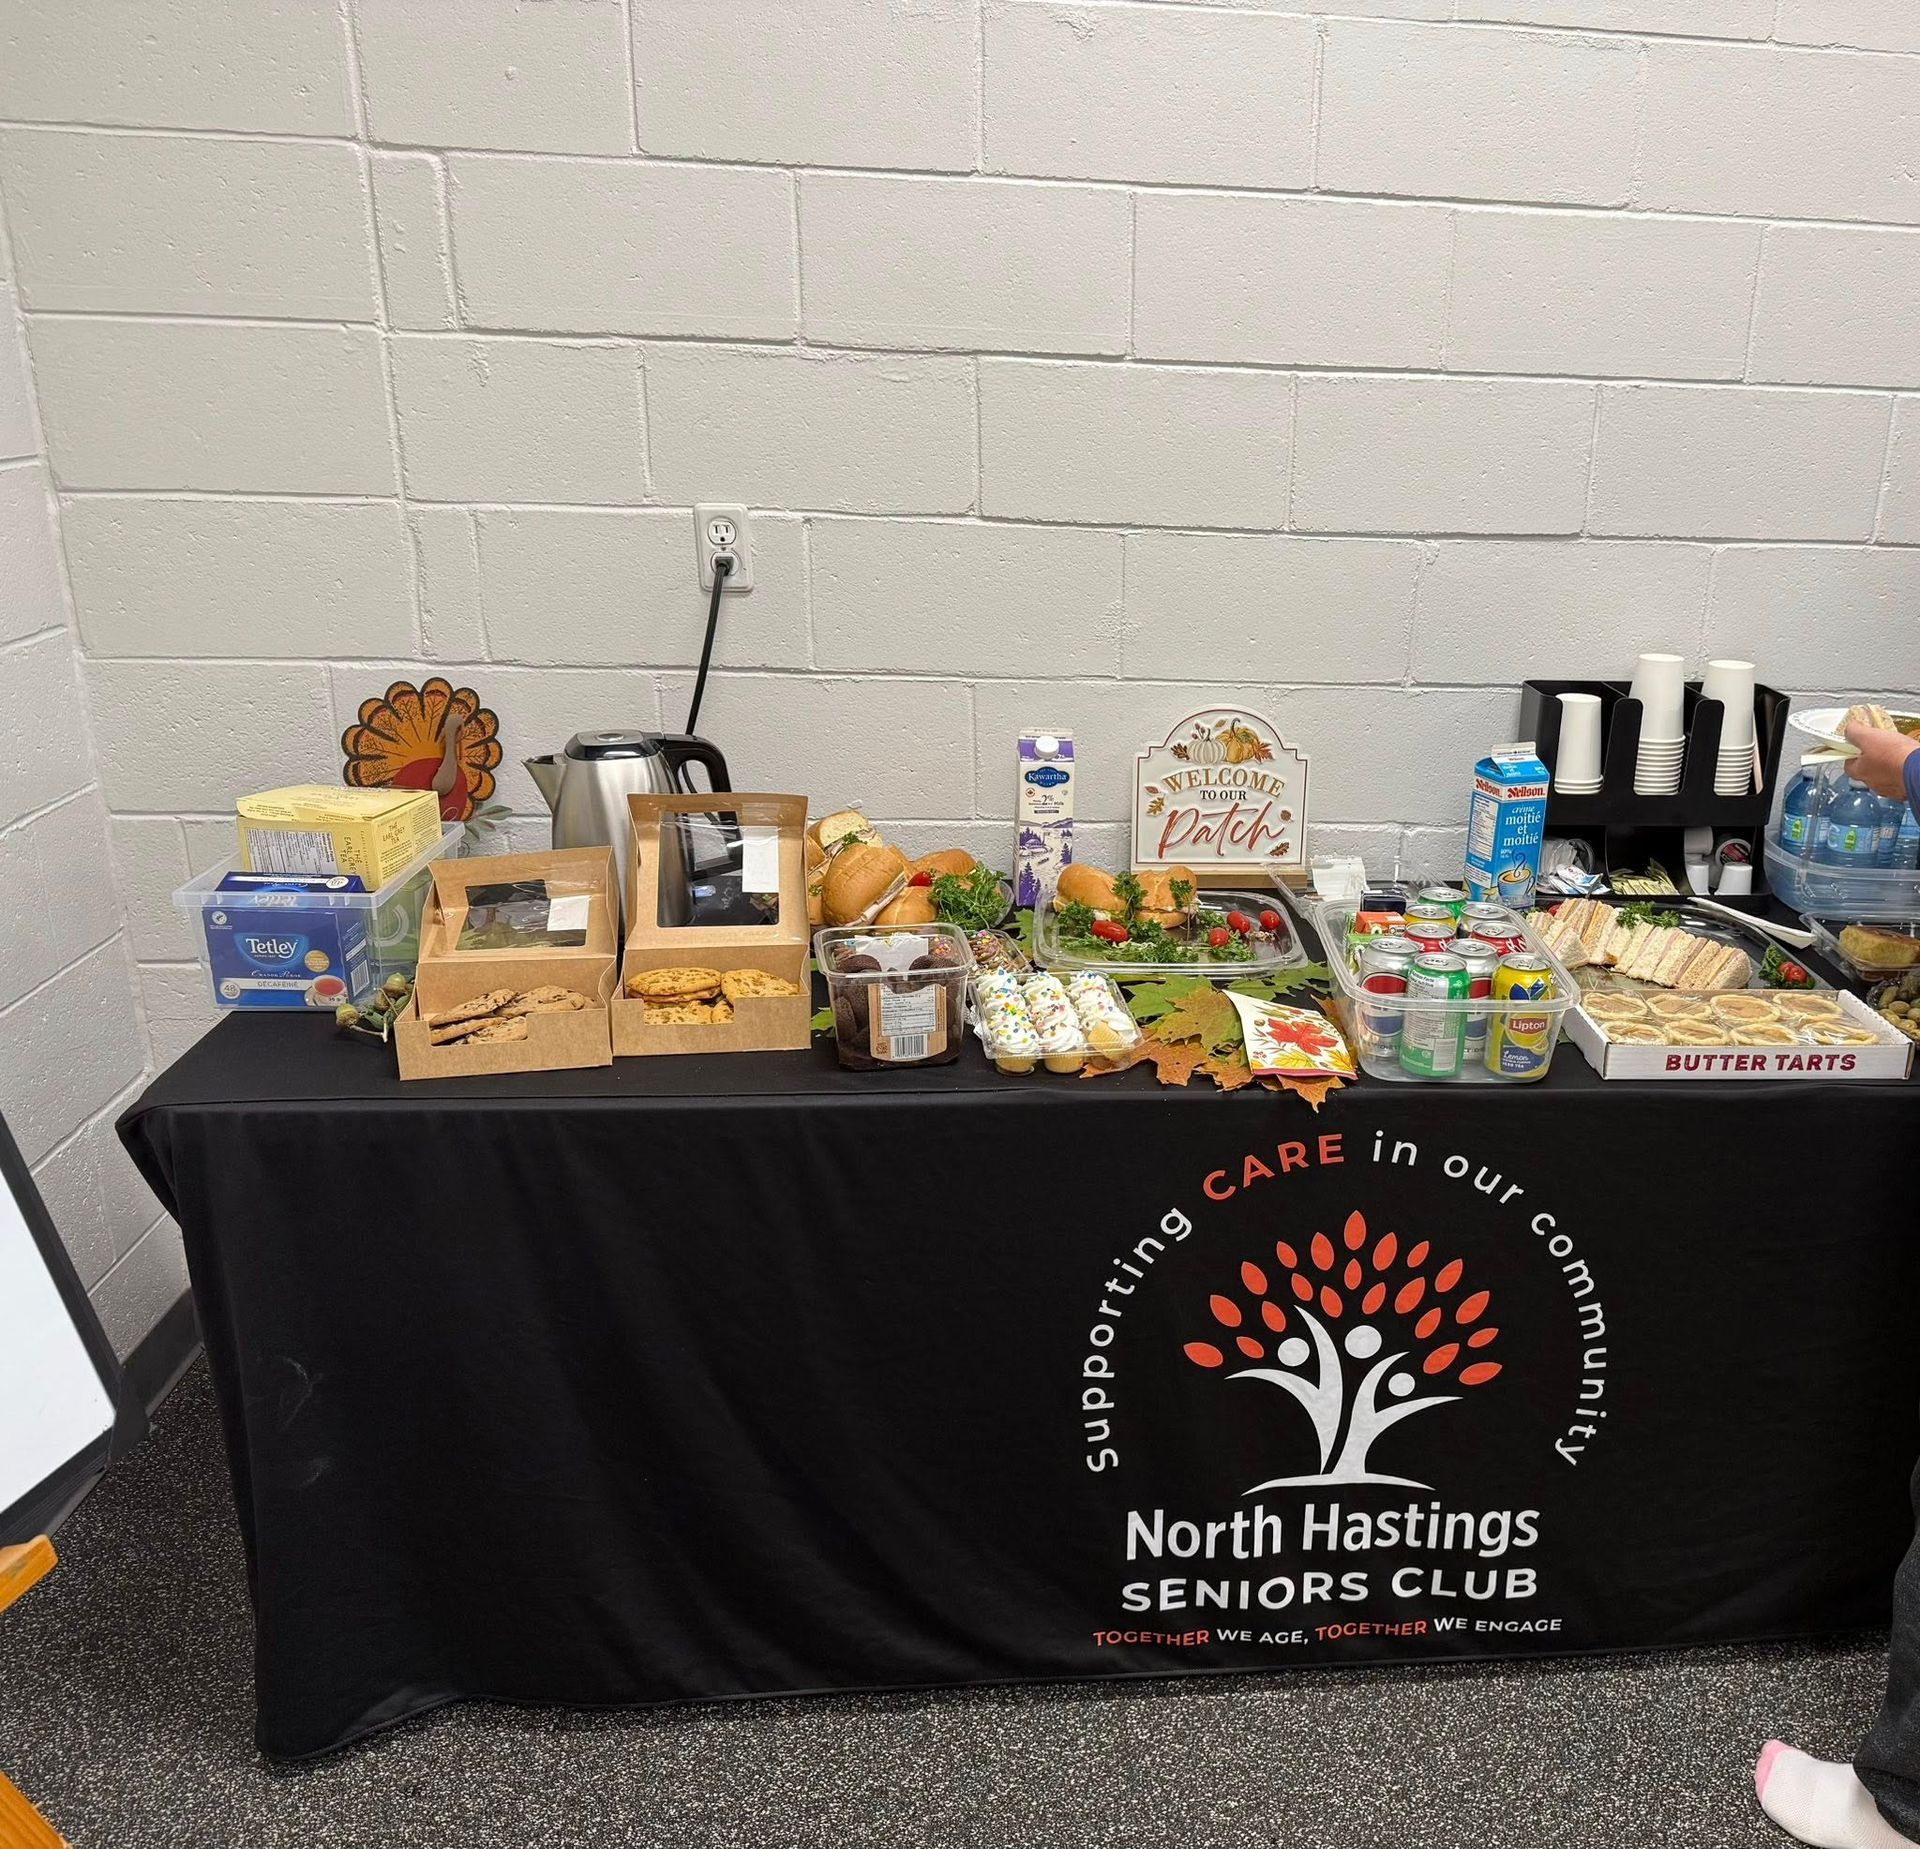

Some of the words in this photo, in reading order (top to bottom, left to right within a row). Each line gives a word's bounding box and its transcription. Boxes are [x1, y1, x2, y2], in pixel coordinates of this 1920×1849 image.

[1028, 773, 1067, 782] Kawartha
[1161, 768, 1286, 798] WELCOME
[1200, 790, 1216, 800] TO
[1219, 790, 1247, 800] OUR
[1475, 778, 1502, 798] Neilson
[1507, 787, 1546, 798] Neilson
[388, 820, 398, 830] THE
[1506, 811, 1541, 826] moitié
[1157, 800, 1286, 860] Patch
[1517, 824, 1528, 835] et
[382, 832, 394, 842] EARL
[1503, 833, 1539, 846] moitié
[344, 836, 353, 854] EARL
[354, 850, 362, 864] THE
[245, 938, 298, 959] Tetley
[224, 984, 236, 992] 48
[1512, 1019, 1546, 1032] Lipton
[1503, 1050, 1529, 1061] Lemon
[1666, 1054, 1767, 1071] BUTTER
[1775, 1054, 1856, 1070] TARTS
[1081, 1206, 1194, 1473] Supporting
[1202, 1133, 1346, 1201] CARE
[1372, 1130, 1418, 1166] in
[1443, 1154, 1524, 1204] our
[1530, 1212, 1608, 1467] community
[1127, 1505, 1281, 1560] North
[1303, 1502, 1540, 1557] Hastings
[1122, 1572, 1368, 1611] SENIORS
[1392, 1567, 1536, 1599] CLUB
[1093, 1631, 1209, 1646] TOGETHER
[1217, 1629, 1251, 1641] WE
[1259, 1631, 1308, 1644] AGE,
[1315, 1621, 1426, 1640] TOGETHER
[1434, 1618, 1467, 1631] WE
[1476, 1619, 1562, 1632] ENGAGE
